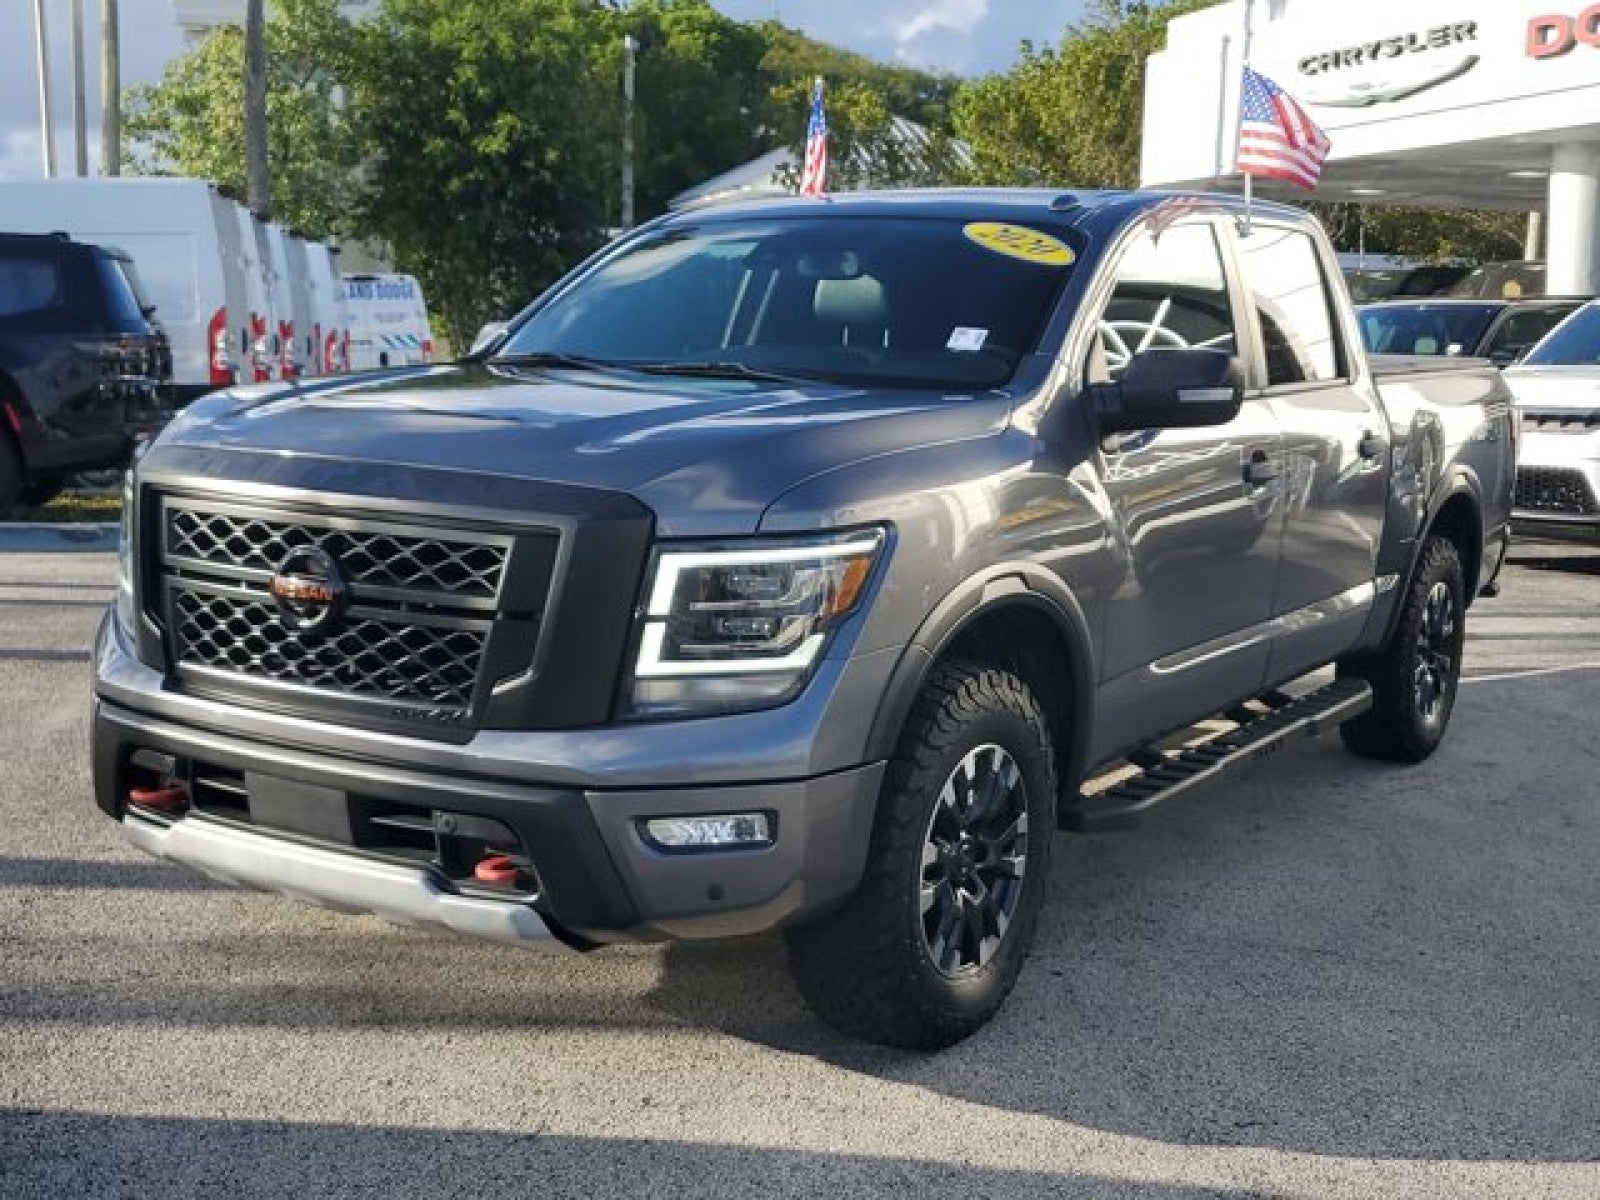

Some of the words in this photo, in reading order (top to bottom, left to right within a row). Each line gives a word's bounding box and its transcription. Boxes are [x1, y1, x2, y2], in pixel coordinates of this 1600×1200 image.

[1297, 20, 1478, 76] CHRYSLER
[975, 226, 1064, 255] 2020
[377, 282, 413, 300] DODGE
